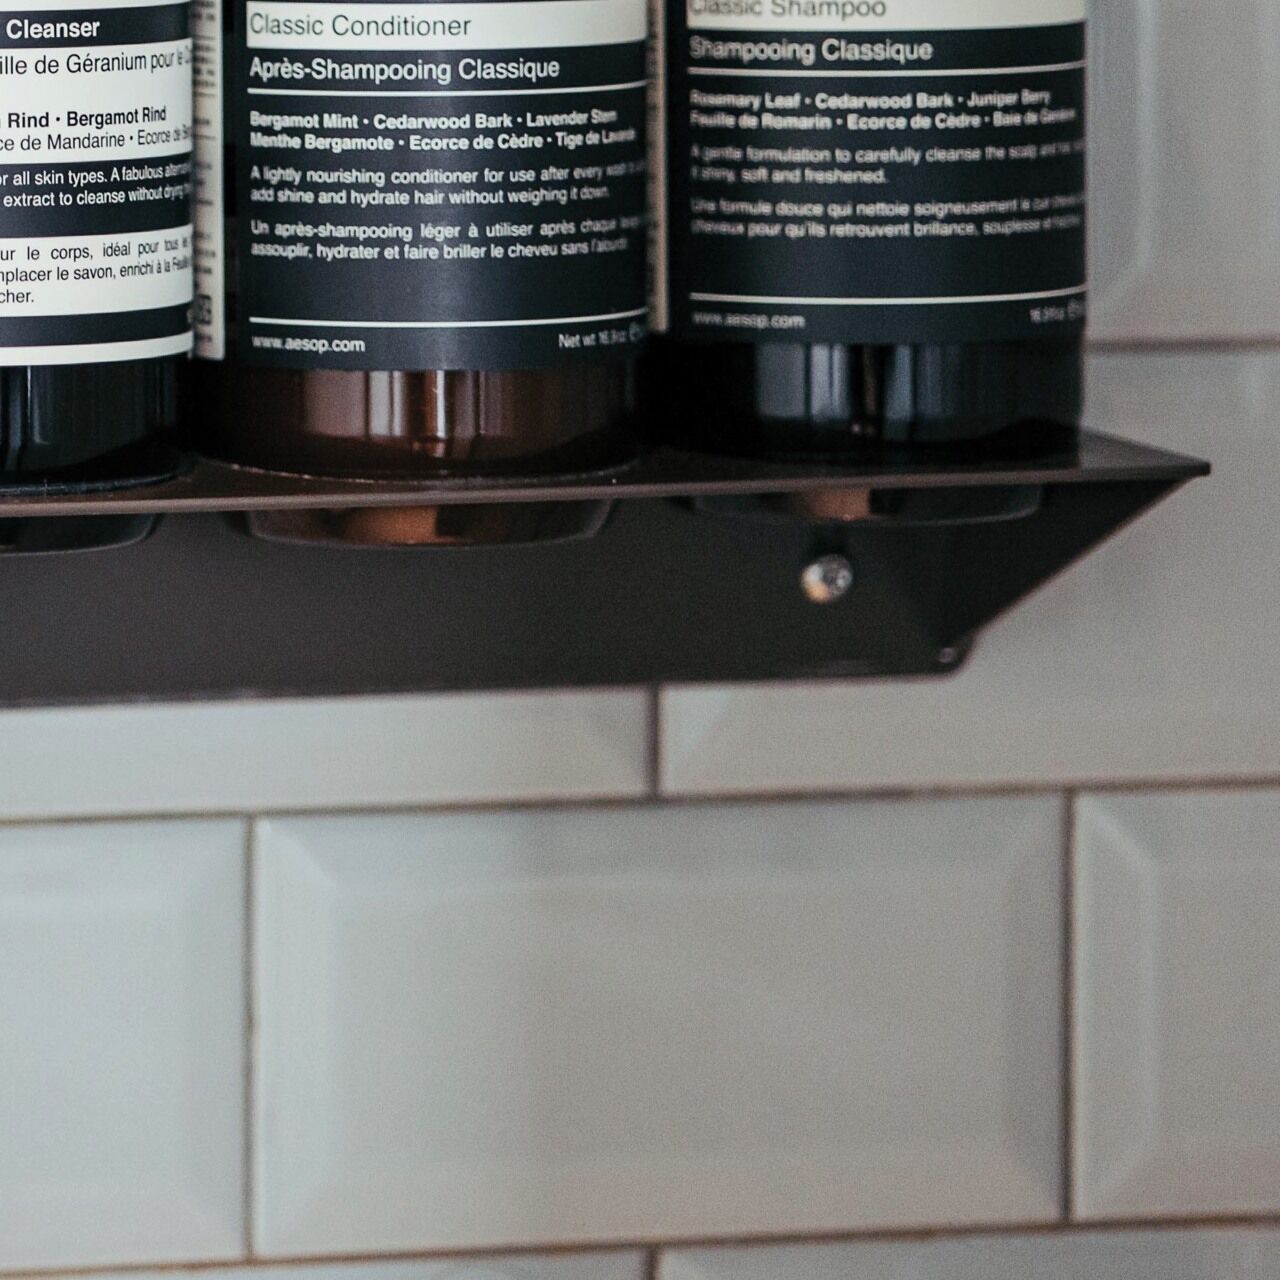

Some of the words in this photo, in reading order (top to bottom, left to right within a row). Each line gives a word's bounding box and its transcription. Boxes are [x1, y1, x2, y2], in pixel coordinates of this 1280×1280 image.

[6, 19, 100, 39] Cleanser
[250, 13, 324, 35] Classic
[332, 15, 471, 37] Conditioner
[690, 36, 815, 65] Shampooing
[822, 39, 933, 64] Classique
[35, 54, 59, 74] de
[66, 52, 146, 73] Géranium
[151, 54, 174, 73] pour
[250, 57, 451, 85] Après-Shampooing
[458, 58, 560, 82] Classique
[690, 91, 761, 111] Rosemary
[765, 92, 800, 109] Leaf
[815, 93, 912, 110] Cedarwood
[916, 92, 954, 108] Bark
[967, 91, 1018, 108] Juniper
[8, 112, 49, 128] Rind
[67, 109, 138, 129] Bergamot
[143, 106, 166, 122] Rind
[250, 111, 319, 131] Bergamot
[323, 113, 358, 129] Mint
[374, 114, 470, 129] Cedarwood
[476, 113, 512, 128] Bark
[527, 111, 588, 127] Lavender
[738, 114, 758, 129] de
[762, 113, 831, 129] Romarin
[847, 114, 907, 130] Ecorce
[911, 114, 931, 129] de
[20, 135, 41, 151] de
[48, 132, 125, 149] Mandarine
[138, 129, 170, 145] Ecorce
[251, 131, 300, 149] Menthe
[304, 133, 394, 152] Bergamote
[410, 135, 468, 151] Ecorce
[473, 135, 493, 150] de
[498, 133, 543, 149] Cèdre
[555, 132, 583, 150] Tige
[586, 131, 600, 145] de
[746, 146, 831, 163] formulation
[835, 147, 851, 163] to
[855, 146, 920, 165] carefully
[925, 146, 981, 162] cleanse
[13, 171, 30, 186] all
[35, 170, 64, 185] skin
[68, 170, 107, 188] types.
[111, 167, 120, 182] A
[122, 165, 163, 181] fabulous
[251, 166, 260, 181] A
[263, 166, 301, 185] lightly
[307, 167, 384, 186] nourishing
[391, 168, 477, 183] conditioner
[484, 168, 504, 182] for
[509, 170, 535, 182] use
[540, 167, 569, 181] after
[741, 166, 769, 183] soft
[771, 167, 801, 183] and
[804, 166, 887, 183] freshened.
[3, 192, 55, 207] extract
[59, 192, 72, 206] to
[77, 190, 125, 205] cleanse
[128, 186, 163, 202] without
[251, 187, 274, 202] add
[277, 187, 314, 203] shine
[318, 188, 346, 204] and
[351, 189, 410, 208] hydrate
[414, 188, 444, 204] hair
[449, 188, 504, 204] without
[508, 187, 567, 206] weighing
[571, 186, 578, 200] it
[775, 200, 823, 216] douce
[856, 200, 910, 216] nettoie
[251, 221, 270, 236] Un
[275, 222, 413, 242] après-shampooing
[420, 222, 460, 241] léger
[468, 222, 479, 238] à
[486, 222, 533, 237] utiliser
[540, 220, 576, 237] après
[830, 222, 910, 237] retrouvent
[27, 246, 40, 260] le
[51, 247, 93, 262] corps,
[103, 241, 130, 257] idéal
[138, 243, 159, 257] pour
[251, 241, 313, 259] assouplir,
[316, 243, 380, 261] hydrater
[384, 245, 400, 259] et
[404, 243, 439, 259] faire
[443, 243, 486, 259] briller
[490, 243, 504, 258] le
[508, 243, 558, 257] cheveu
[561, 241, 589, 255] sans
[57, 266, 68, 281] le
[73, 268, 116, 281] savon,
[120, 260, 154, 277] enrichi
[252, 336, 365, 353] www.aesop.com
